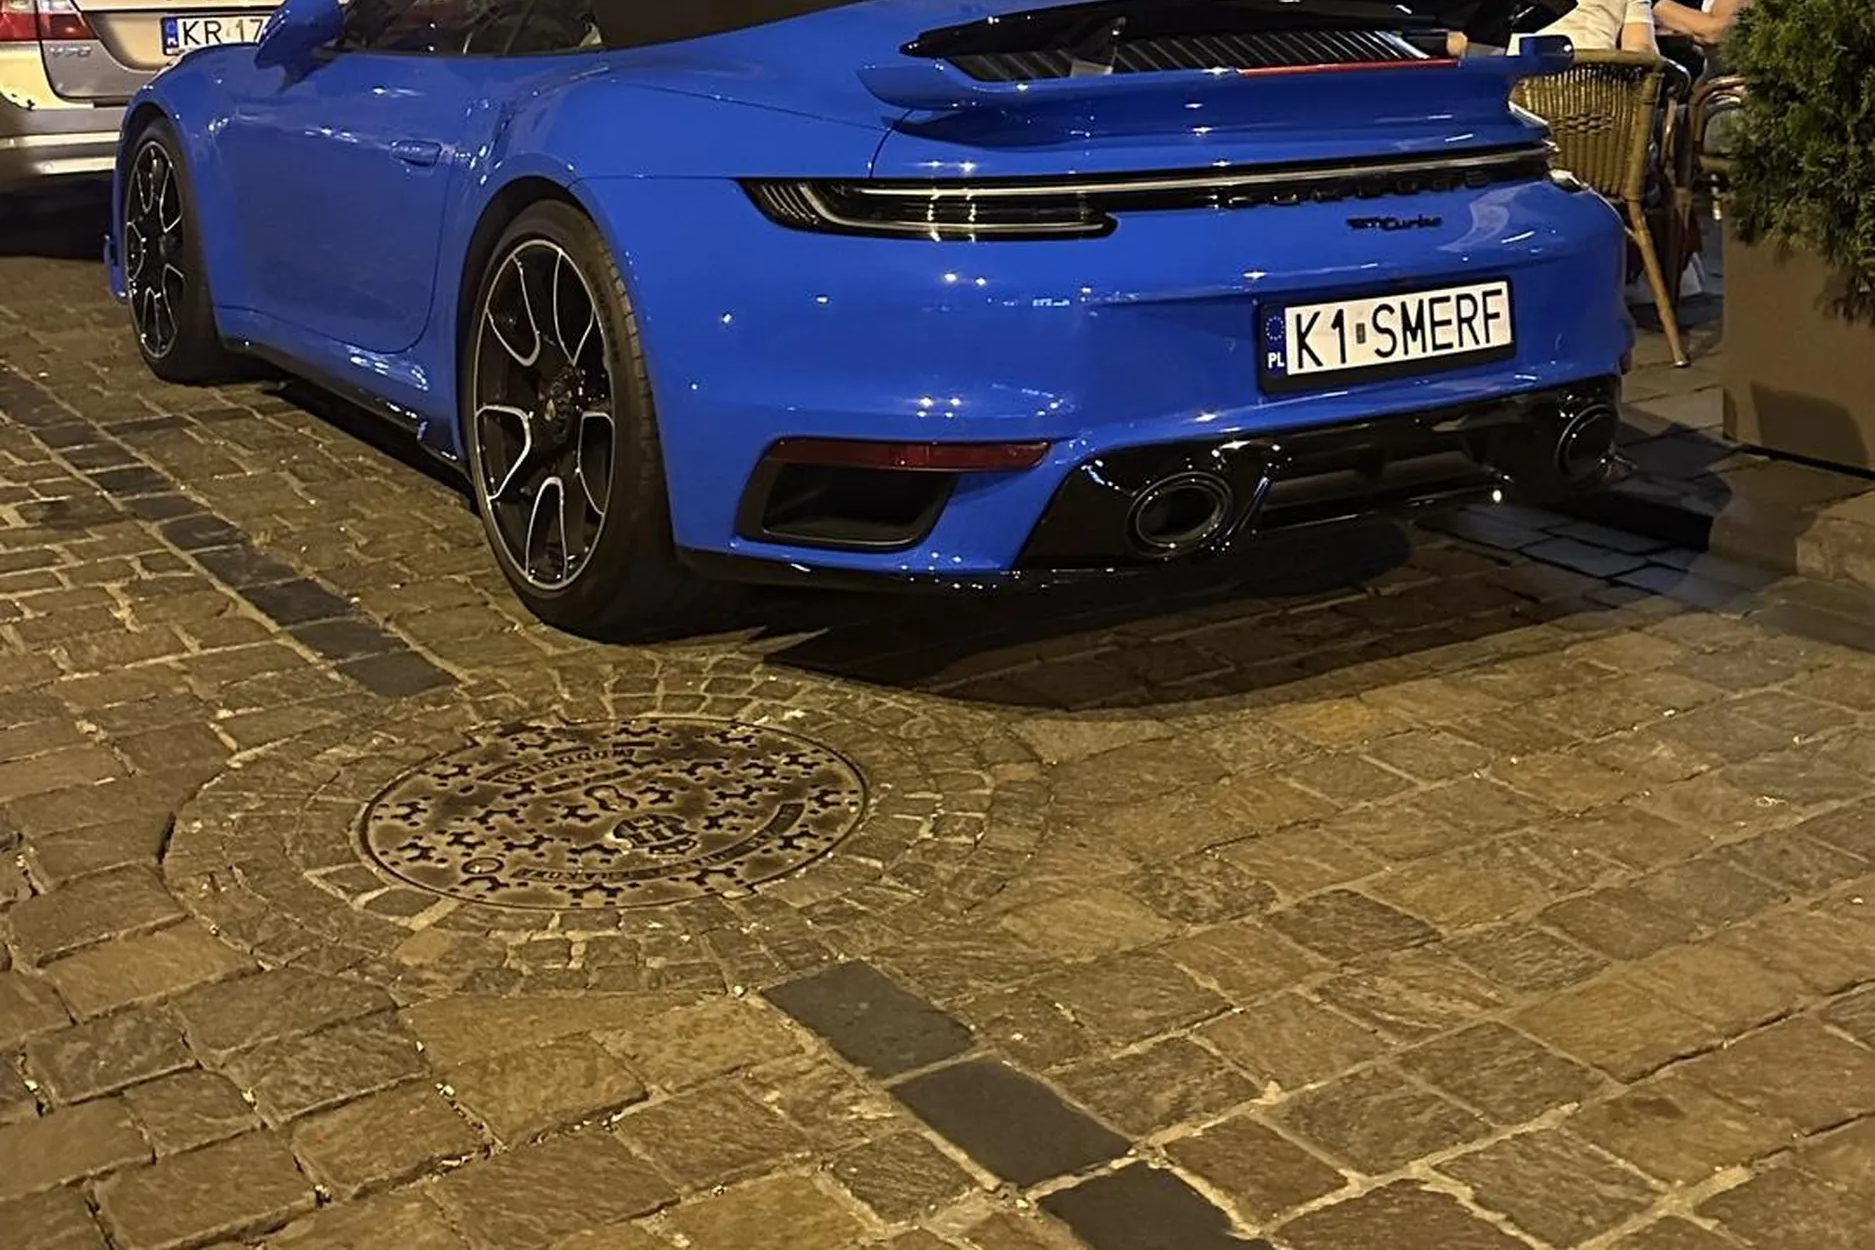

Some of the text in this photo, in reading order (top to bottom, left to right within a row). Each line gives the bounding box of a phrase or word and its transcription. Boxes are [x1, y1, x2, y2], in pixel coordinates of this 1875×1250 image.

[183, 18, 264, 45] KR 17
[1295, 289, 1503, 369] K1 SMERF
[1267, 352, 1285, 369] PL
